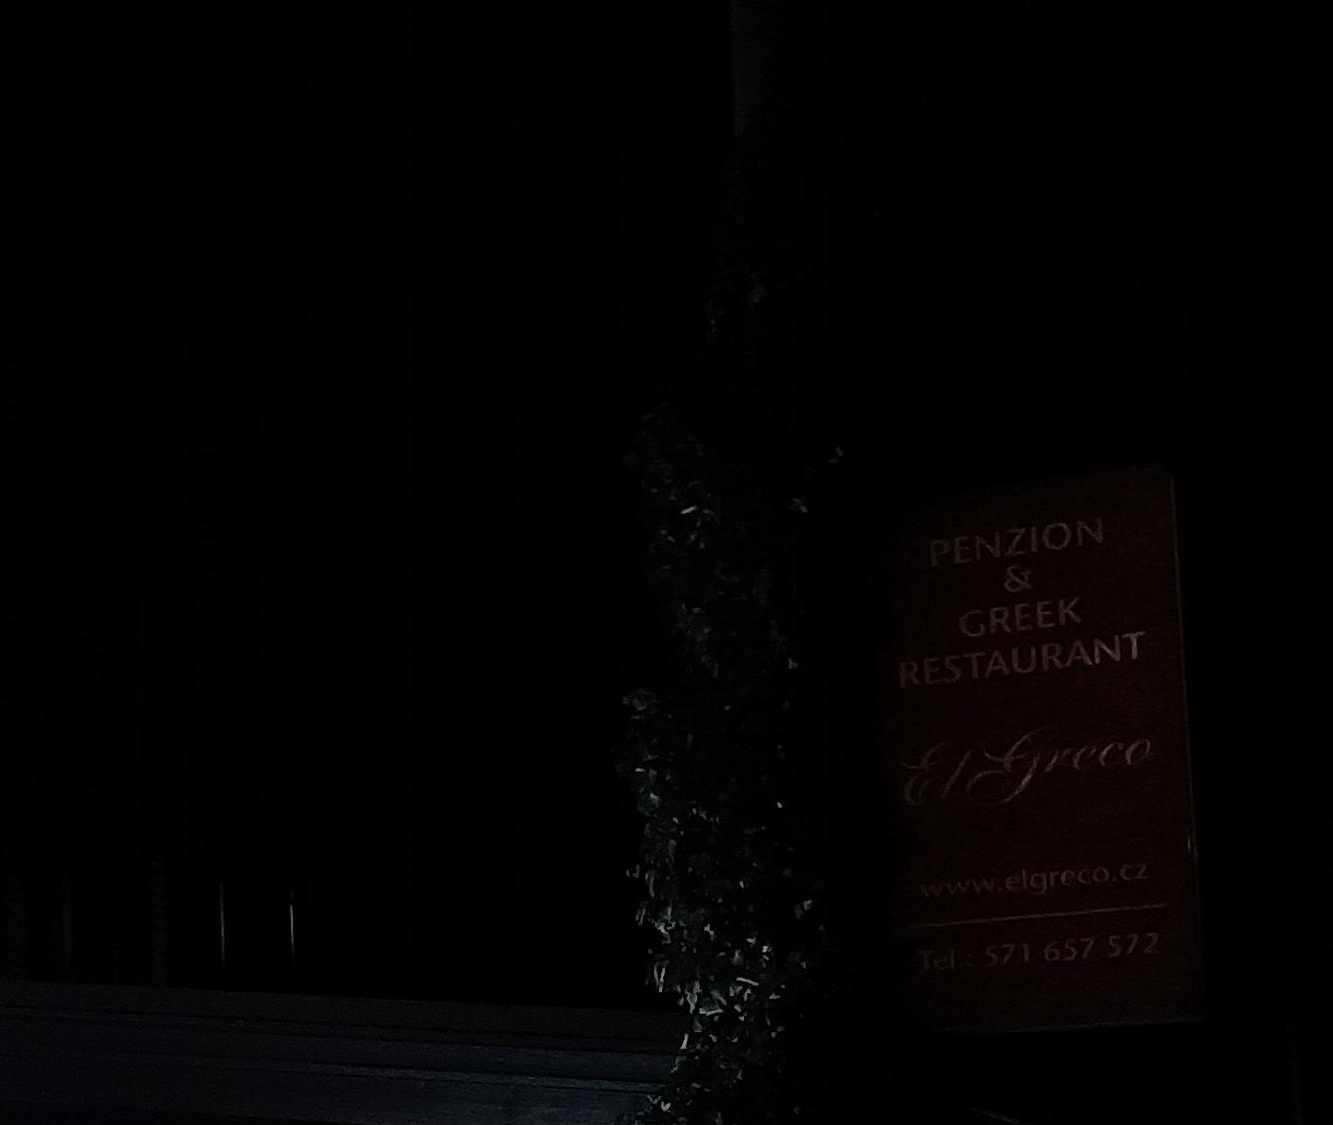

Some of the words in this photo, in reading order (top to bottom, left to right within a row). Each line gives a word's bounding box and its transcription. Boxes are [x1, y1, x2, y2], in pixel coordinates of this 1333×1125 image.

[929, 516, 1104, 567] PENZION
[1002, 564, 1032, 593] &
[958, 597, 1081, 638] GREEK
[899, 630, 1147, 688] RESTAURANT
[902, 741, 973, 806] El
[965, 727, 1153, 803] Greco
[919, 864, 1150, 896] www.elgreco.cz
[985, 943, 1029, 966] 571
[1044, 937, 1094, 962] 657
[1108, 932, 1158, 958] 572
